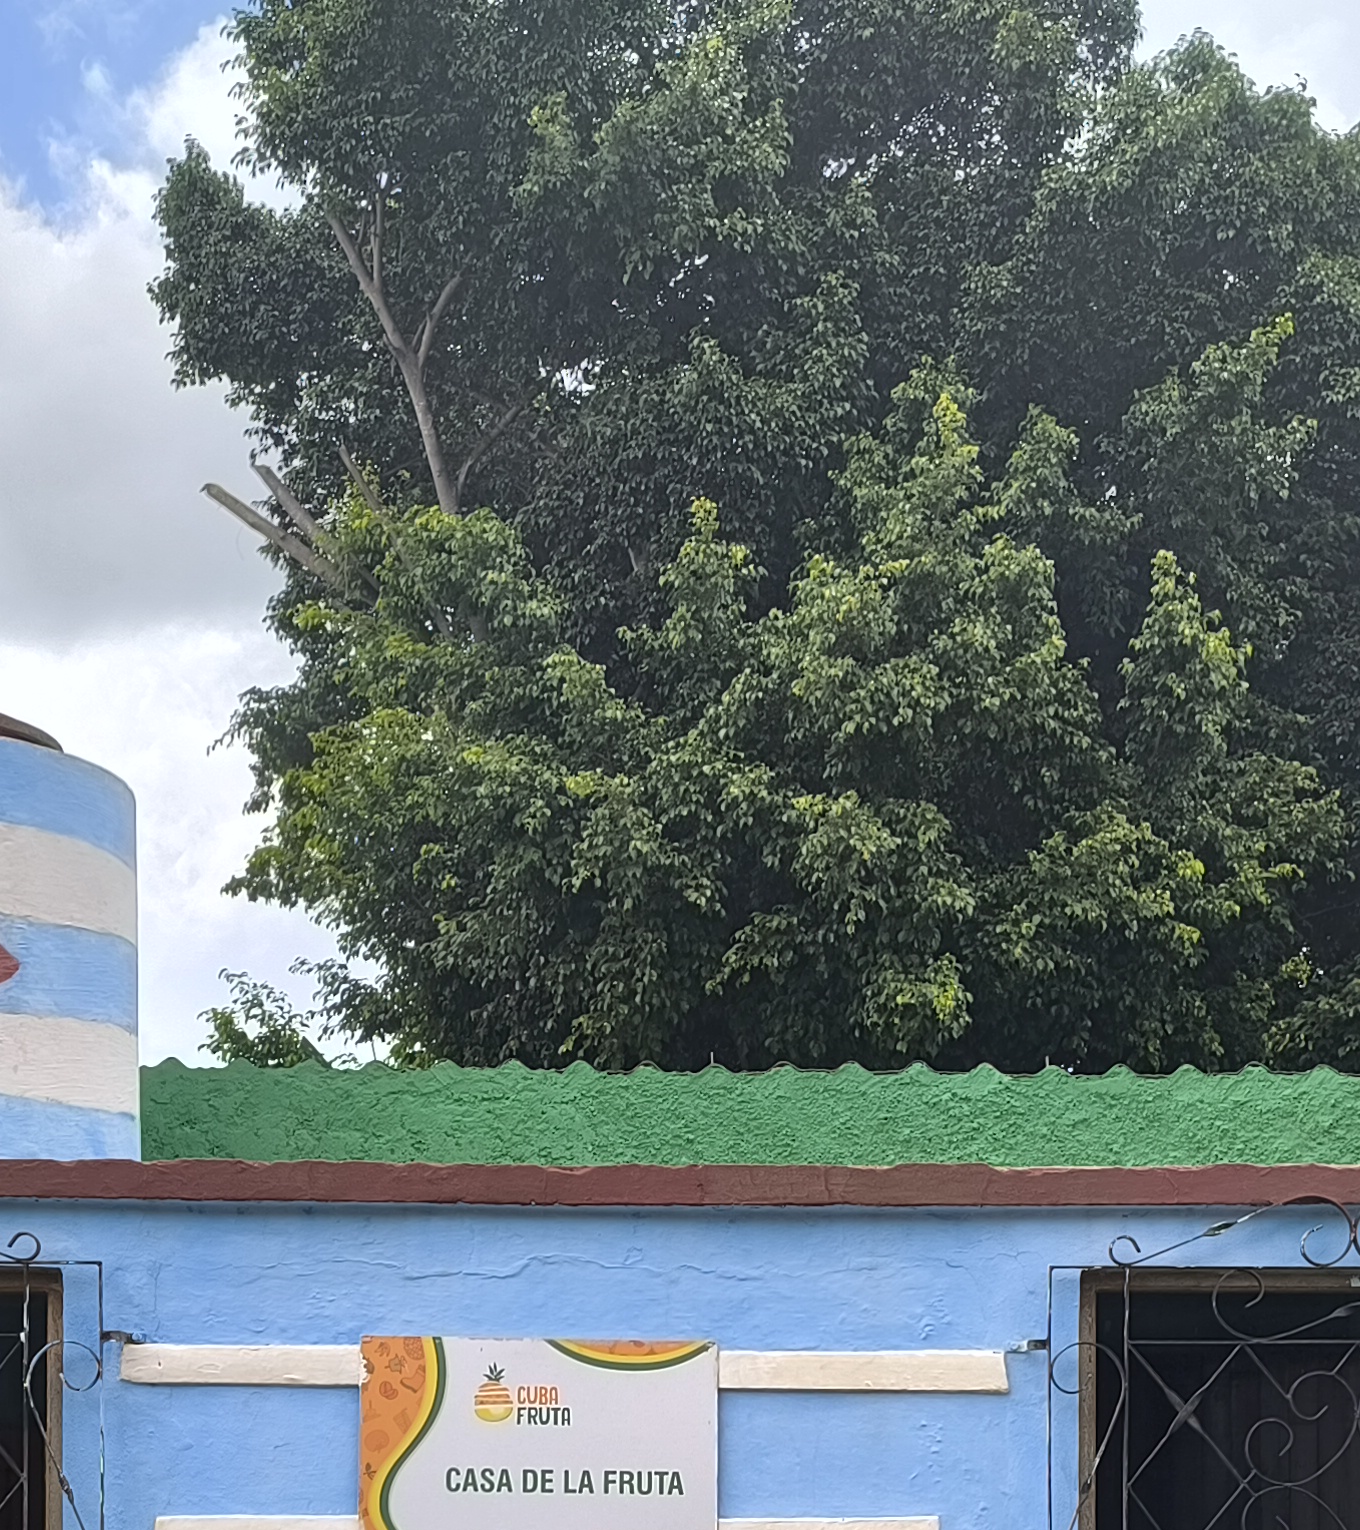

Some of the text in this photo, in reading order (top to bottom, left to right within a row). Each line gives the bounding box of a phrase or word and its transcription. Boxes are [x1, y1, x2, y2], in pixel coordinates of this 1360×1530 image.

[517, 1386, 558, 1405] CUBA
[517, 1407, 571, 1426] FRUTA
[446, 1467, 684, 1495] CASA DE LA FRUTA
